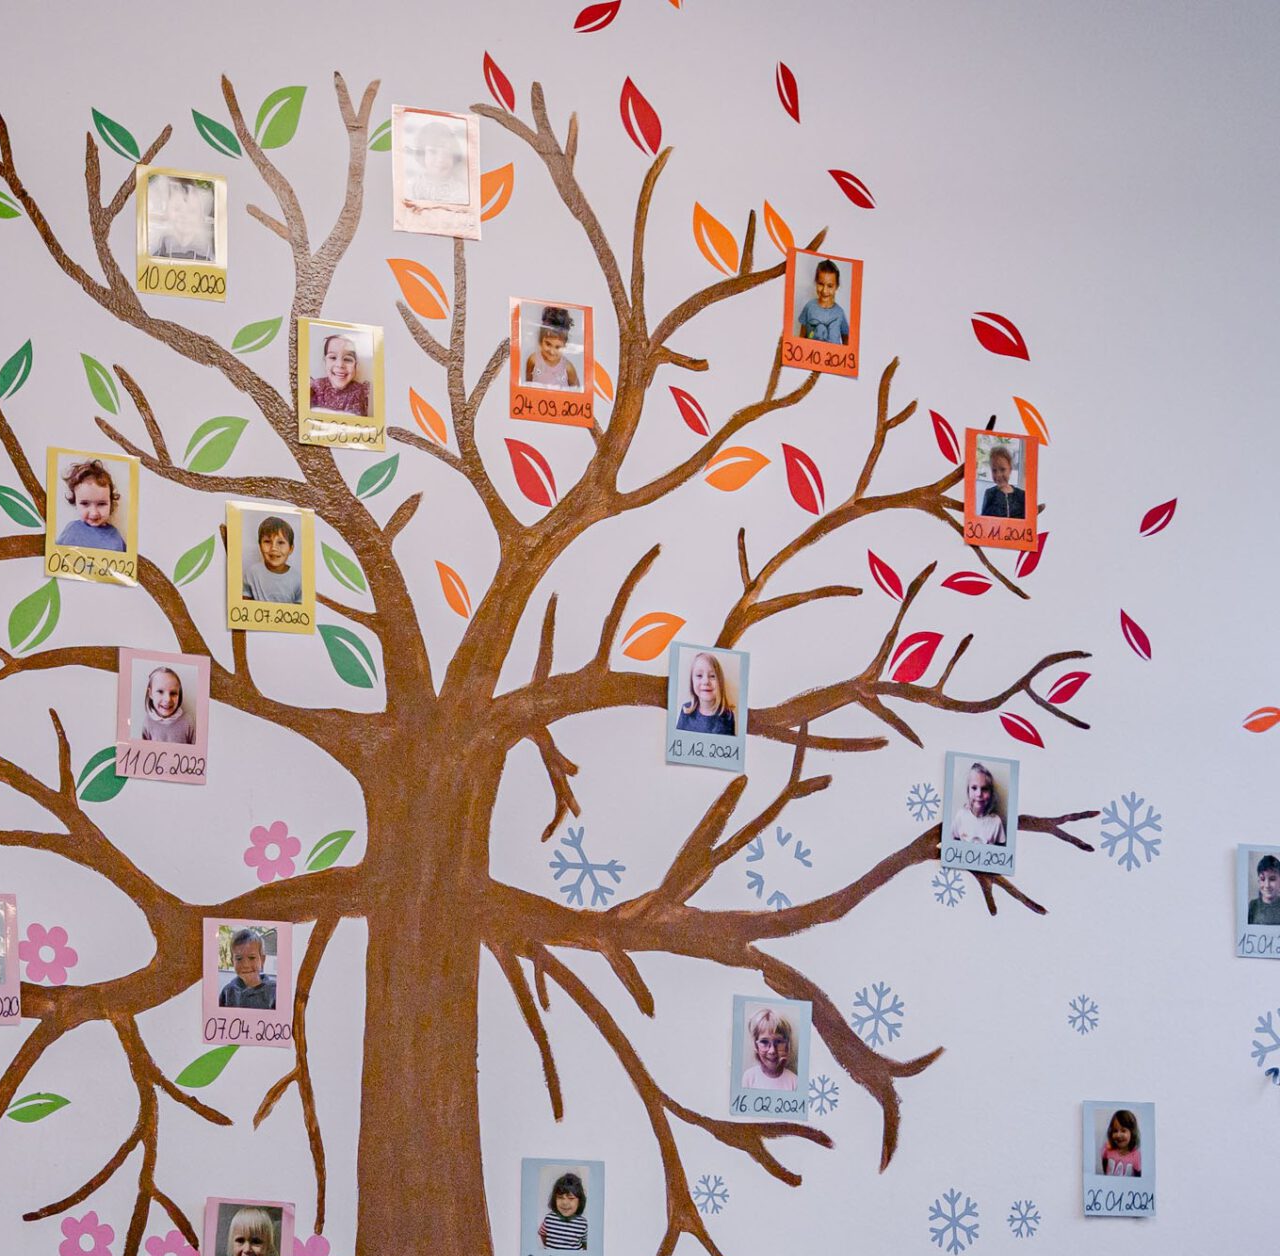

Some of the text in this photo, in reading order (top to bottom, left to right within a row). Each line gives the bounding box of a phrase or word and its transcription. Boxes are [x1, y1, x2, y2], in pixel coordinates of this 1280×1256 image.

[139, 266, 226, 295] 10.08.2020
[784, 342, 856, 369] 30.10.2019
[966, 521, 1033, 543] 30.11.2019
[230, 606, 310, 625] 02.07.2020
[668, 739, 739, 760] 19.12.2021
[204, 1017, 292, 1041] 07.04.2020
